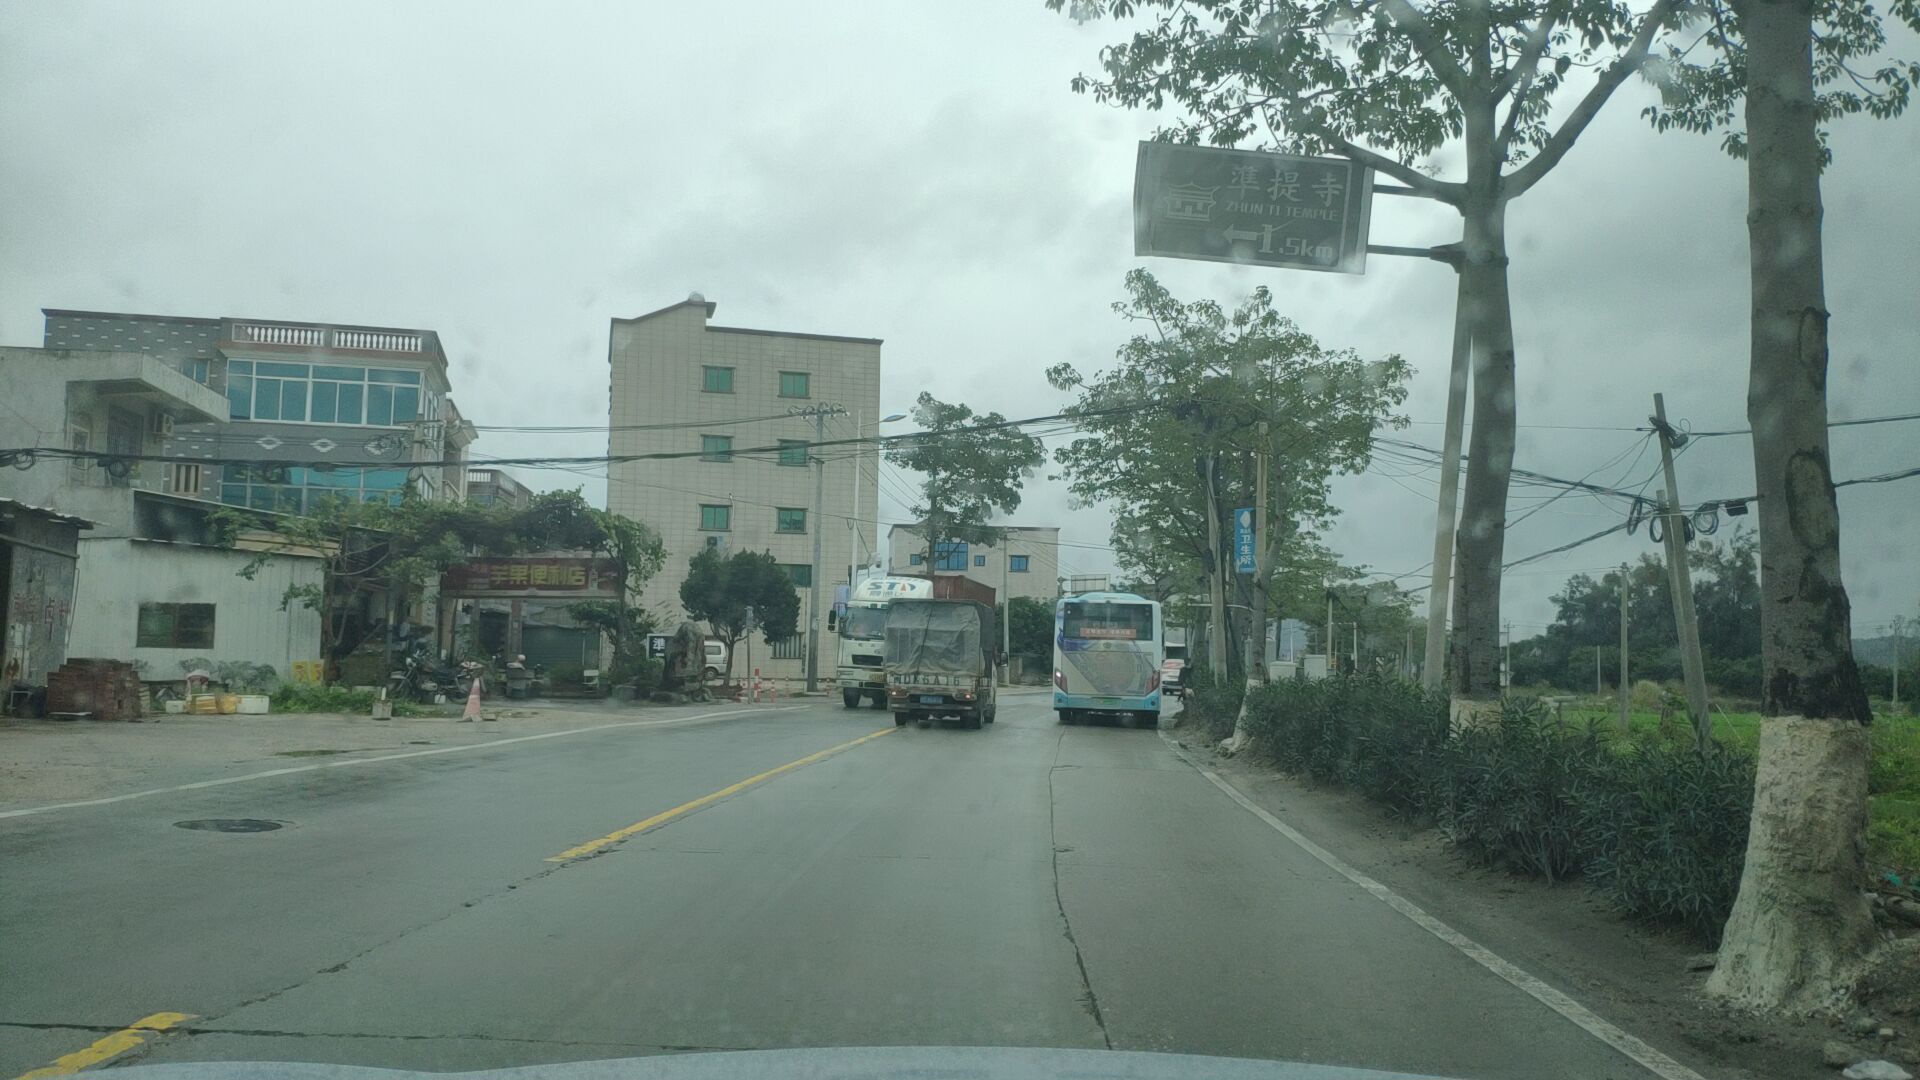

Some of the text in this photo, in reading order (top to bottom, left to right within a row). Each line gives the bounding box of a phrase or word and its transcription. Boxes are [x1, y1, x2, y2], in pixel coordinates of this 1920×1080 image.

[1226, 165, 1344, 208] 準提寺
[1225, 200, 1338, 222] ZHUN TI TEMPLE
